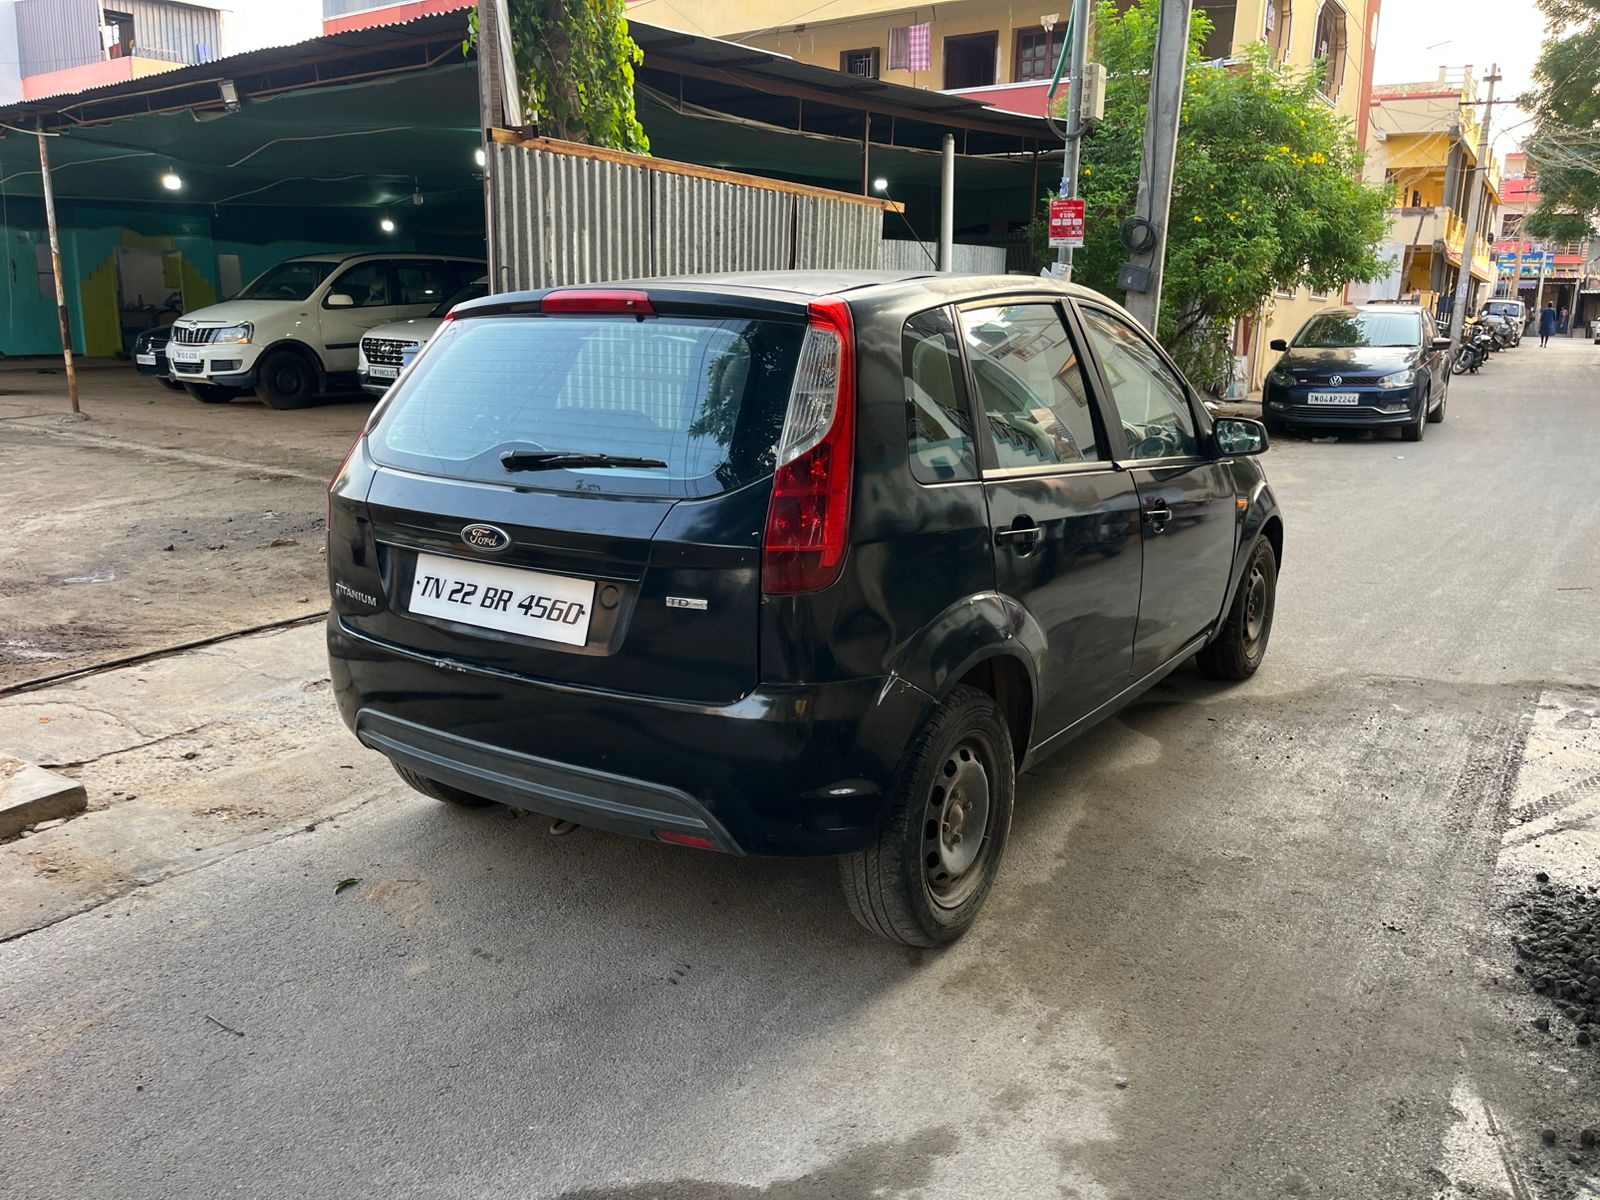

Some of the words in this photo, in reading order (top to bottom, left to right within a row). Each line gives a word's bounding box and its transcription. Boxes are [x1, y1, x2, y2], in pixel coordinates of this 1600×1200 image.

[1310, 395, 1356, 404] TN04AP2244
[469, 529, 498, 547] Ford
[335, 582, 377, 607] TITANIUM
[420, 575, 447, 599] TN
[449, 581, 478, 605] 22
[480, 587, 514, 612] BR
[517, 594, 584, 625] 4560
